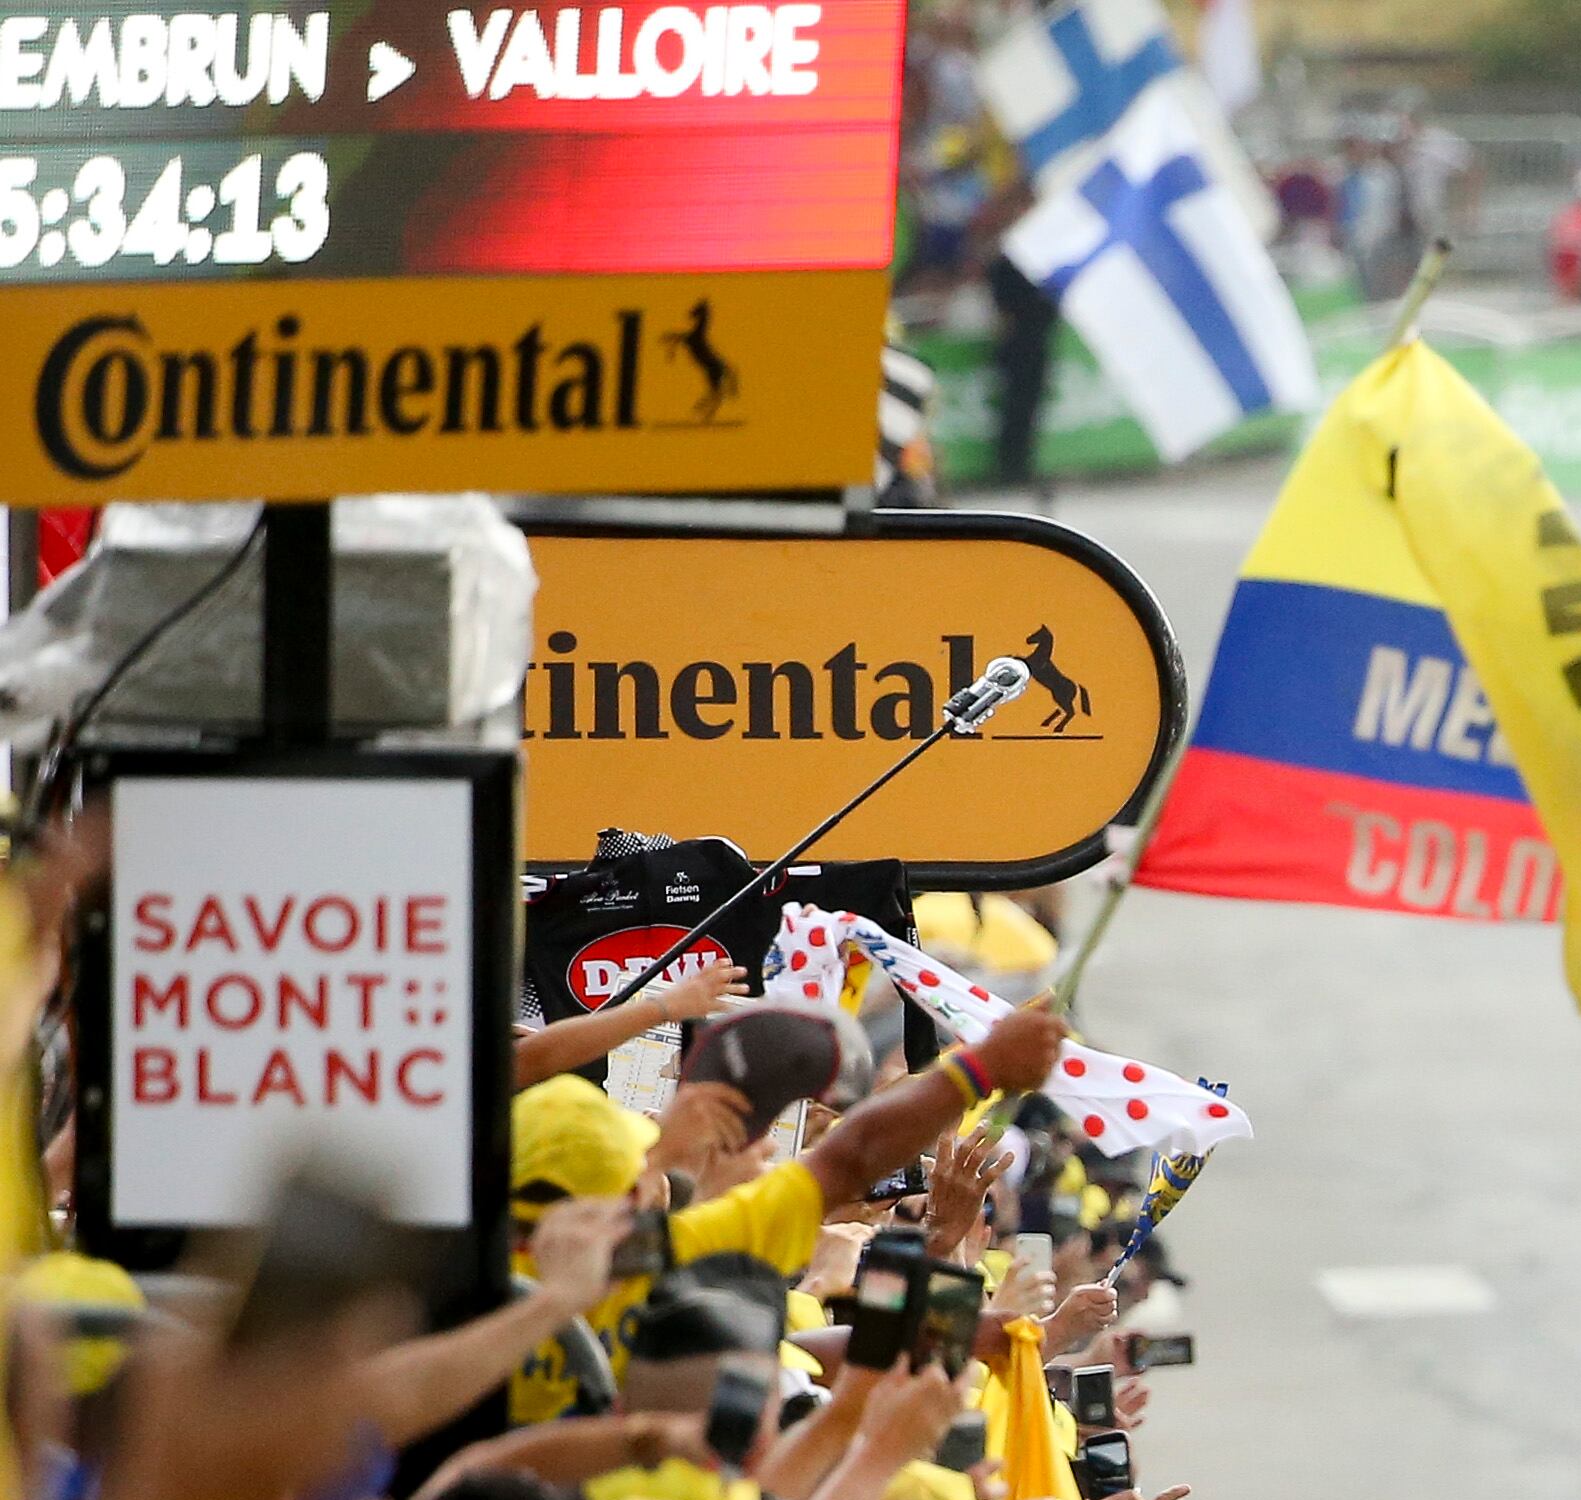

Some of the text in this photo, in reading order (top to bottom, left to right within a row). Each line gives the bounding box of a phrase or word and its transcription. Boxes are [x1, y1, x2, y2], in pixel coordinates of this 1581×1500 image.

[0, 5, 823, 110] EMBRUN VALLOIRE
[0, 151, 330, 268] 5:34:13
[35, 307, 645, 482] Continental
[518, 630, 981, 742] inental
[1352, 644, 1523, 768] ME
[1344, 809, 1567, 924] COLO
[132, 894, 448, 954] SAVOIE
[132, 972, 388, 1030] MONT
[132, 1048, 448, 1107] BLANC
